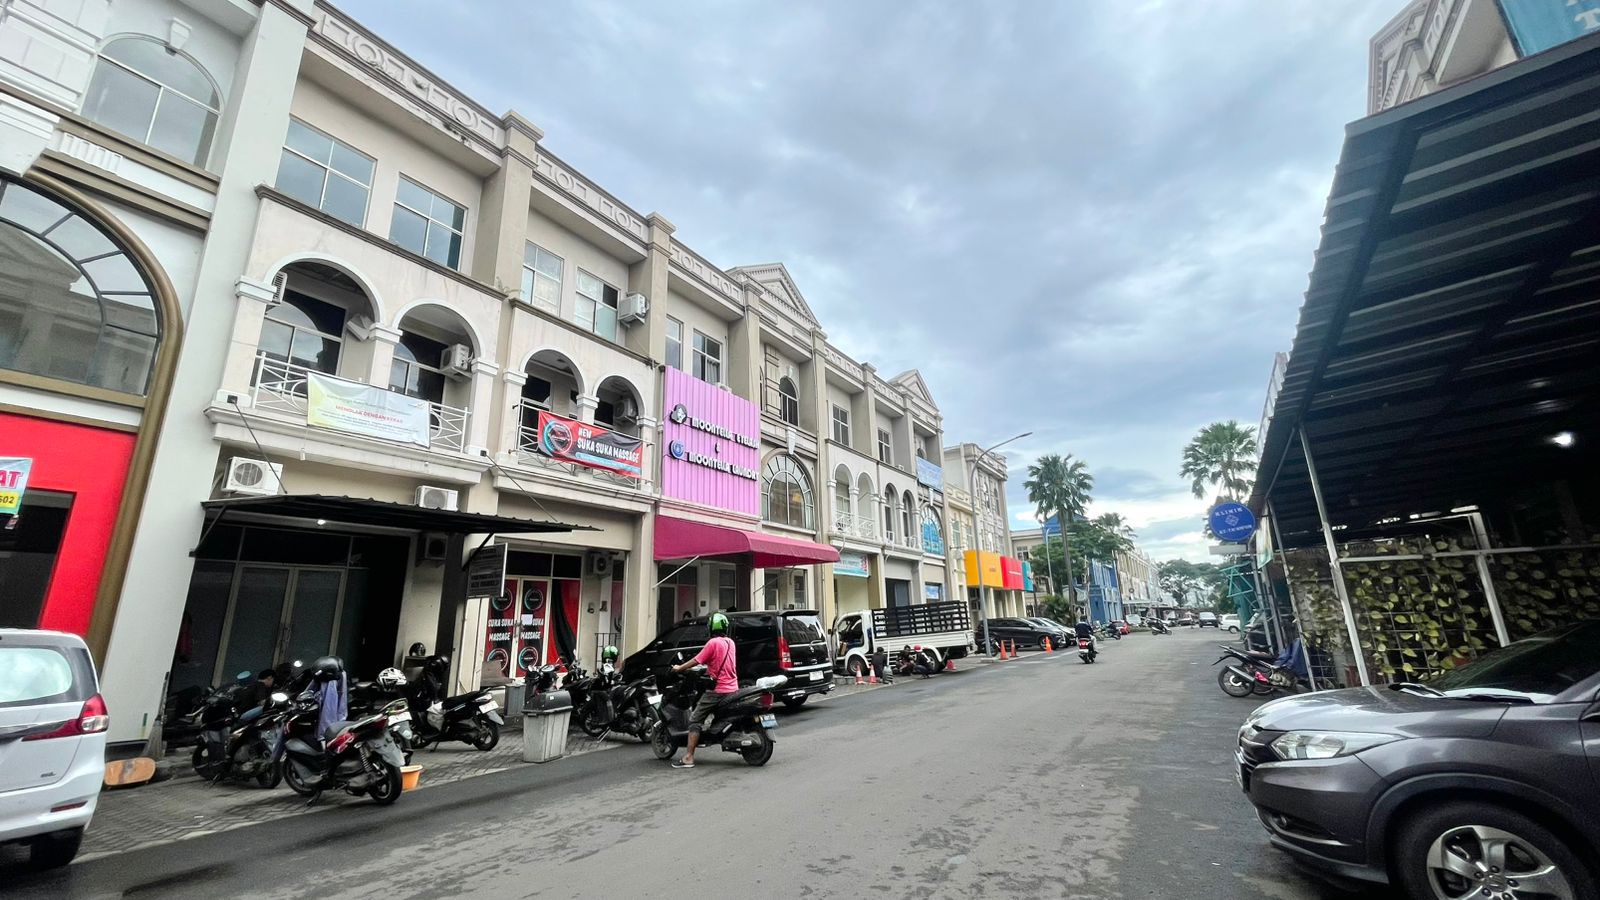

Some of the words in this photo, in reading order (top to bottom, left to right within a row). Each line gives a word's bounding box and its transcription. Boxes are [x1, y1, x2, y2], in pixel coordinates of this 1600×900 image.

[363, 410, 386, 421] DENGAN
[578, 427, 592, 439] NEW
[577, 438, 595, 453] SUKA
[595, 442, 613, 457] SUKA
[613, 447, 640, 463] MASSAGE
[1215, 507, 1243, 517] KLINIK
[488, 618, 500, 627] SUKA
[501, 618, 514, 627] SUKA
[488, 632, 511, 642] MASSAGE
[520, 631, 541, 640] MASSAGE
